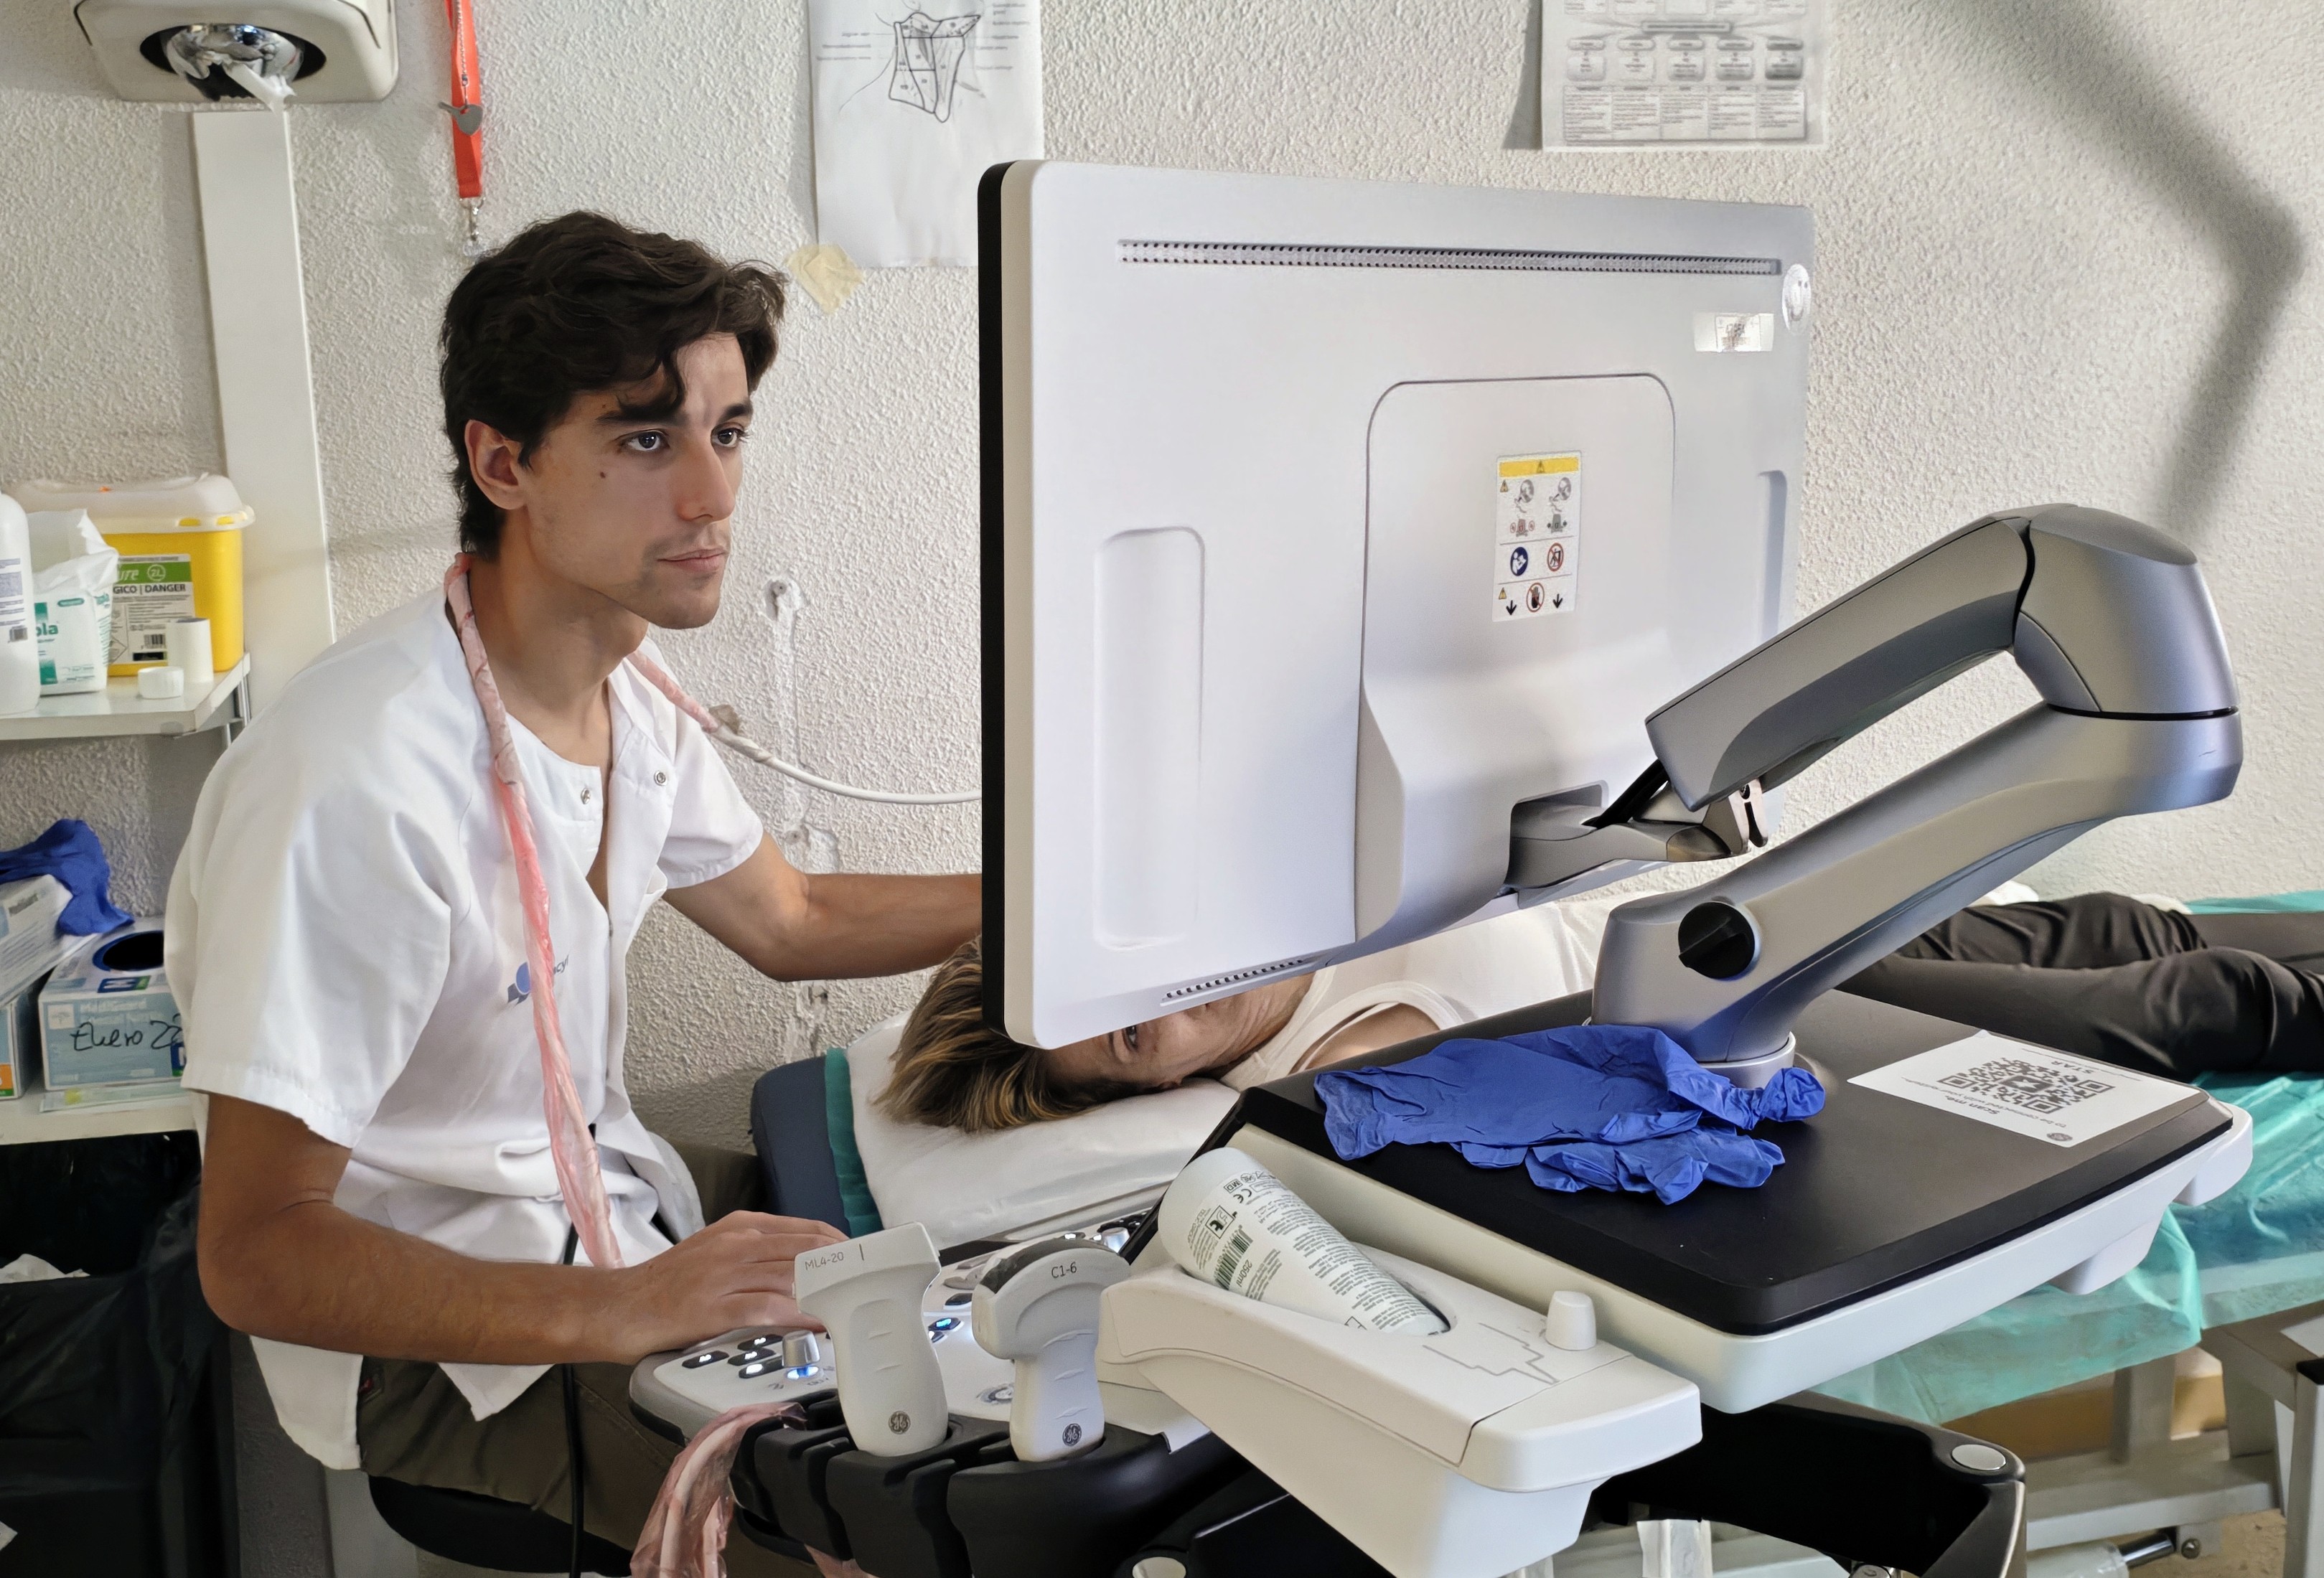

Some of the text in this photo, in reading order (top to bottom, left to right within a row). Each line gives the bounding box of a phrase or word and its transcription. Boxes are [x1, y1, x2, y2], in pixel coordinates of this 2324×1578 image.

[144, 583, 187, 593] DANGER
[2051, 1060, 2095, 1074] STAR
[1968, 1103, 2000, 1114] Scan
[1227, 1180, 1241, 1191] MD
[1232, 1188, 1252, 1203] CE
[805, 1251, 844, 1271] ML4-20
[1051, 1261, 1077, 1279] C1-6
[1236, 1259, 1253, 1287] 250ml
